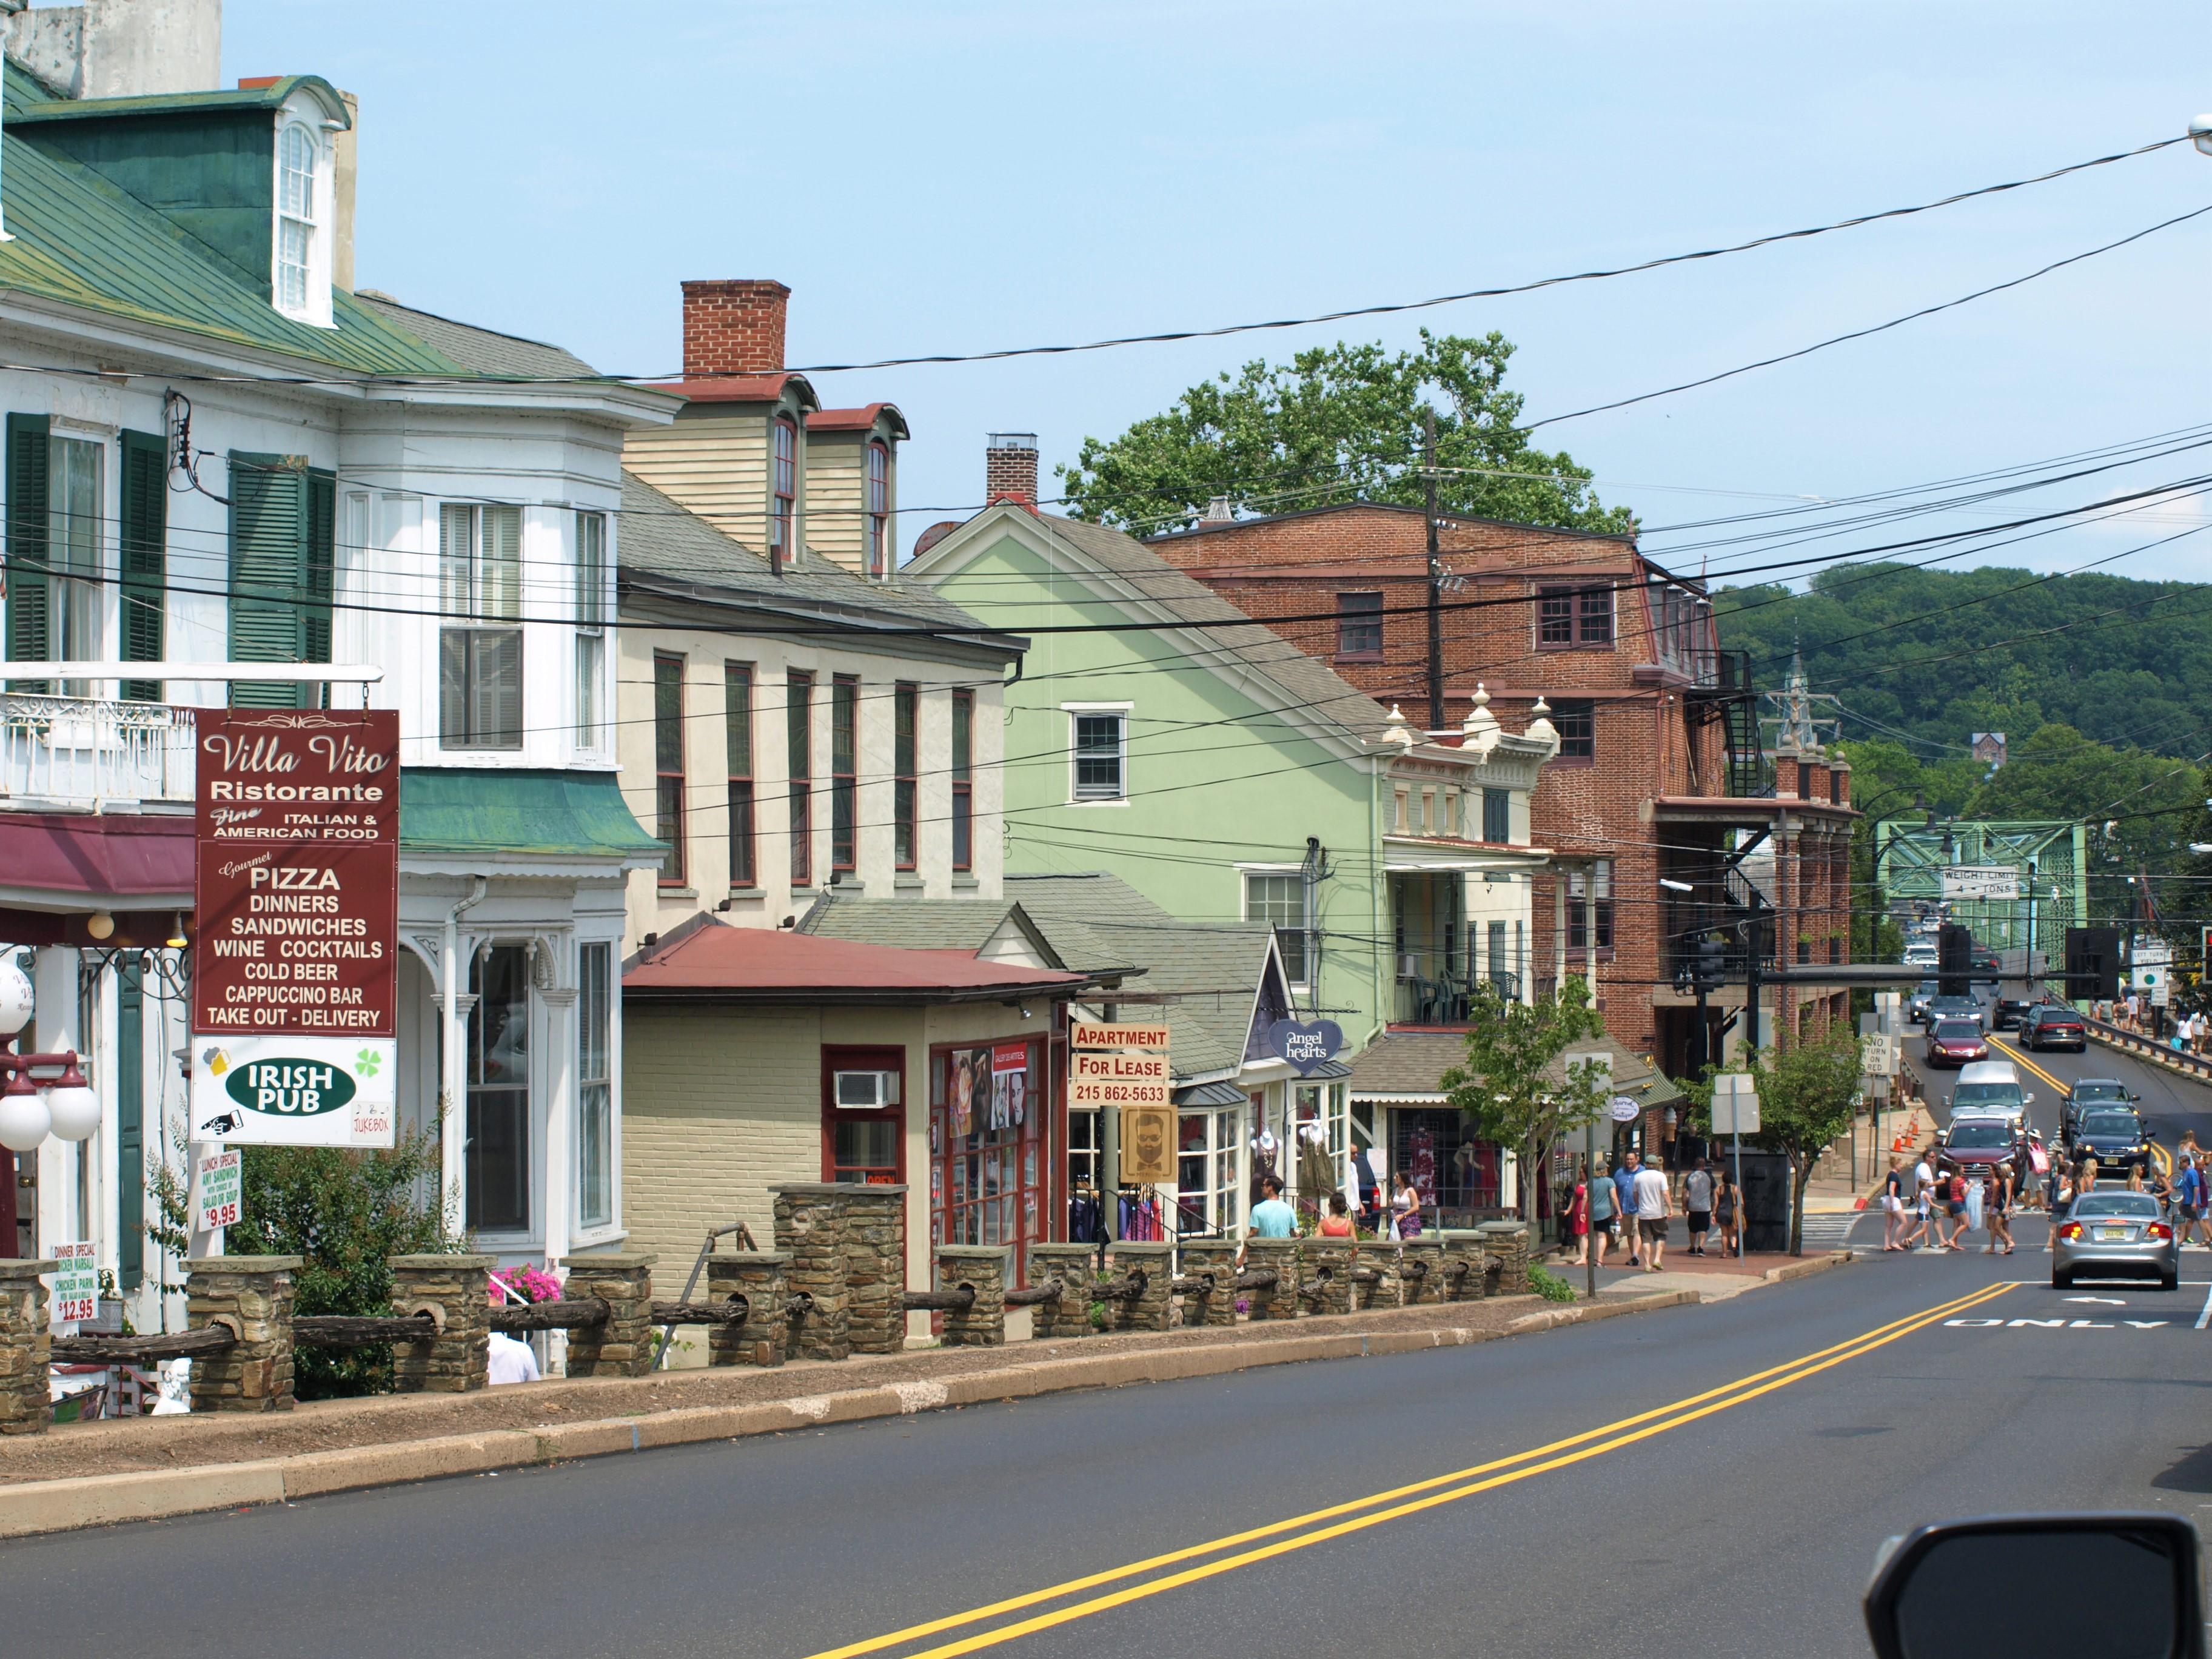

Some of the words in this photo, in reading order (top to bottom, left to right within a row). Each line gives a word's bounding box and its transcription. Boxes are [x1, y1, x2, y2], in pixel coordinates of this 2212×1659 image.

[203, 734, 301, 773] Villa
[309, 734, 390, 773] Vito
[211, 781, 383, 801] Ristorante
[210, 806, 262, 826] Fine
[284, 814, 357, 825] ITALIAN
[364, 815, 377, 825] &
[213, 828, 317, 838] AMERICAN
[323, 828, 378, 839] FOOD
[218, 851, 272, 879] Gourmet
[250, 868, 341, 890] PIZZA
[250, 895, 339, 913] DINNERS
[231, 917, 366, 936] SANDWICHES
[213, 940, 265, 957] WINE
[280, 940, 383, 958] COCKTAILS
[245, 963, 289, 980] COLD
[295, 964, 338, 980] BEER
[226, 985, 326, 1004] CAPPUCCINO
[330, 987, 363, 1004] BAR
[207, 1007, 249, 1024] TAKE
[254, 1008, 287, 1025] OUT
[302, 1010, 380, 1027] DELIVERY
[1076, 1027, 1166, 1045] APARTMENT
[1286, 1031, 1322, 1048] angel
[1871, 1037, 1883, 1047] NO
[1285, 1042, 1327, 1062] hearts
[1080, 1057, 1109, 1075] FOR
[1114, 1058, 1162, 1076] LEASE
[249, 1065, 332, 1089] IRISH
[258, 1088, 320, 1113] PUB
[1077, 1085, 1100, 1101] 215
[1104, 1085, 1164, 1102] 862-5633
[354, 1118, 389, 1135] JUKEBOX
[203, 1172, 212, 1186] ANY
[214, 1165, 238, 1183] SANDWICH
[203, 1195, 217, 1209] SALAD
[218, 1193, 224, 1205] OR
[226, 1190, 238, 1203] SOUP
[206, 1204, 235, 1227] $9.95
[55, 1279, 76, 1292] CHICKEN
[59, 1299, 92, 1321] $12.95
